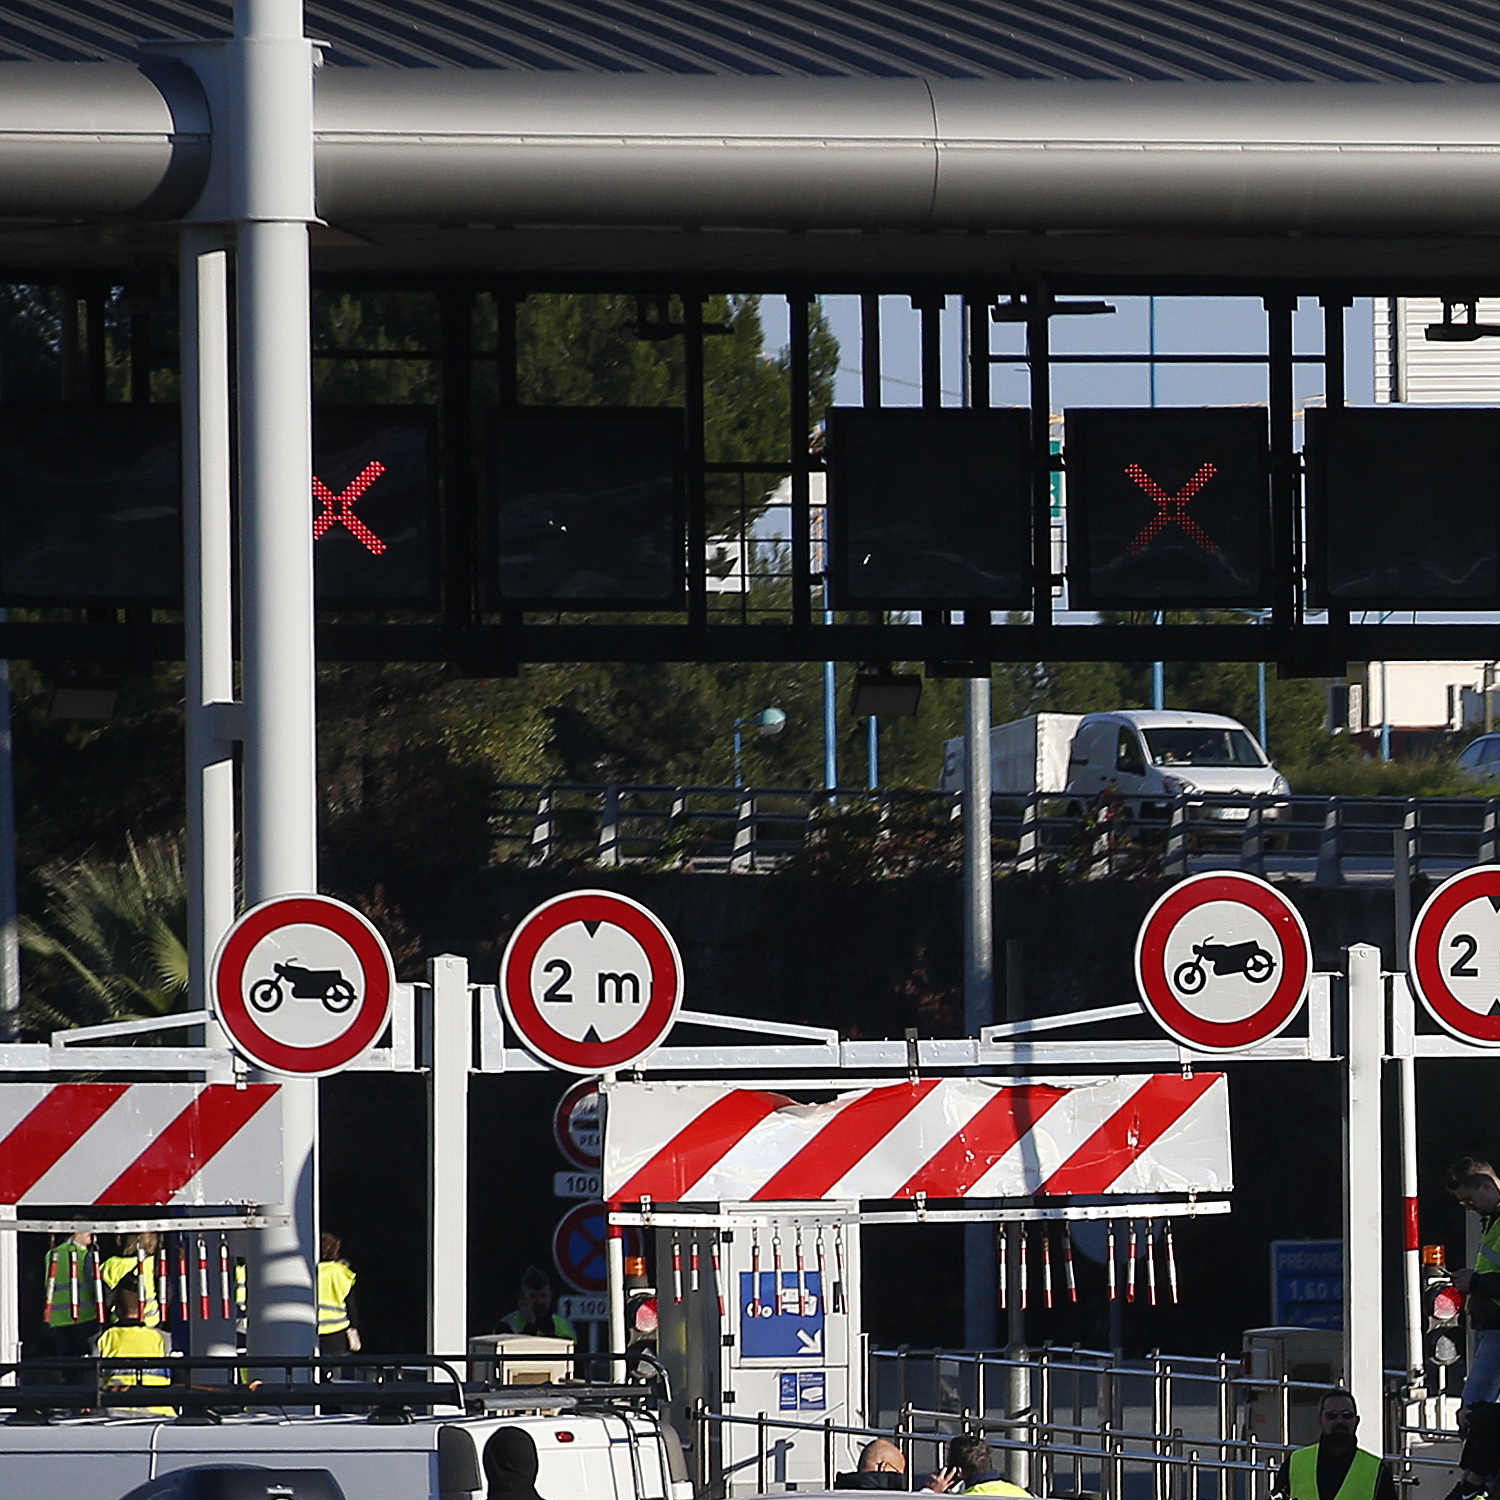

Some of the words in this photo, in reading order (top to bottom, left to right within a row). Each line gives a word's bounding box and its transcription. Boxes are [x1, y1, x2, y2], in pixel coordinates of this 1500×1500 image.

[1450, 934, 1478, 977] 2
[543, 959, 573, 1002] 2
[598, 972, 640, 1003] m
[566, 1176, 599, 1194] 100
